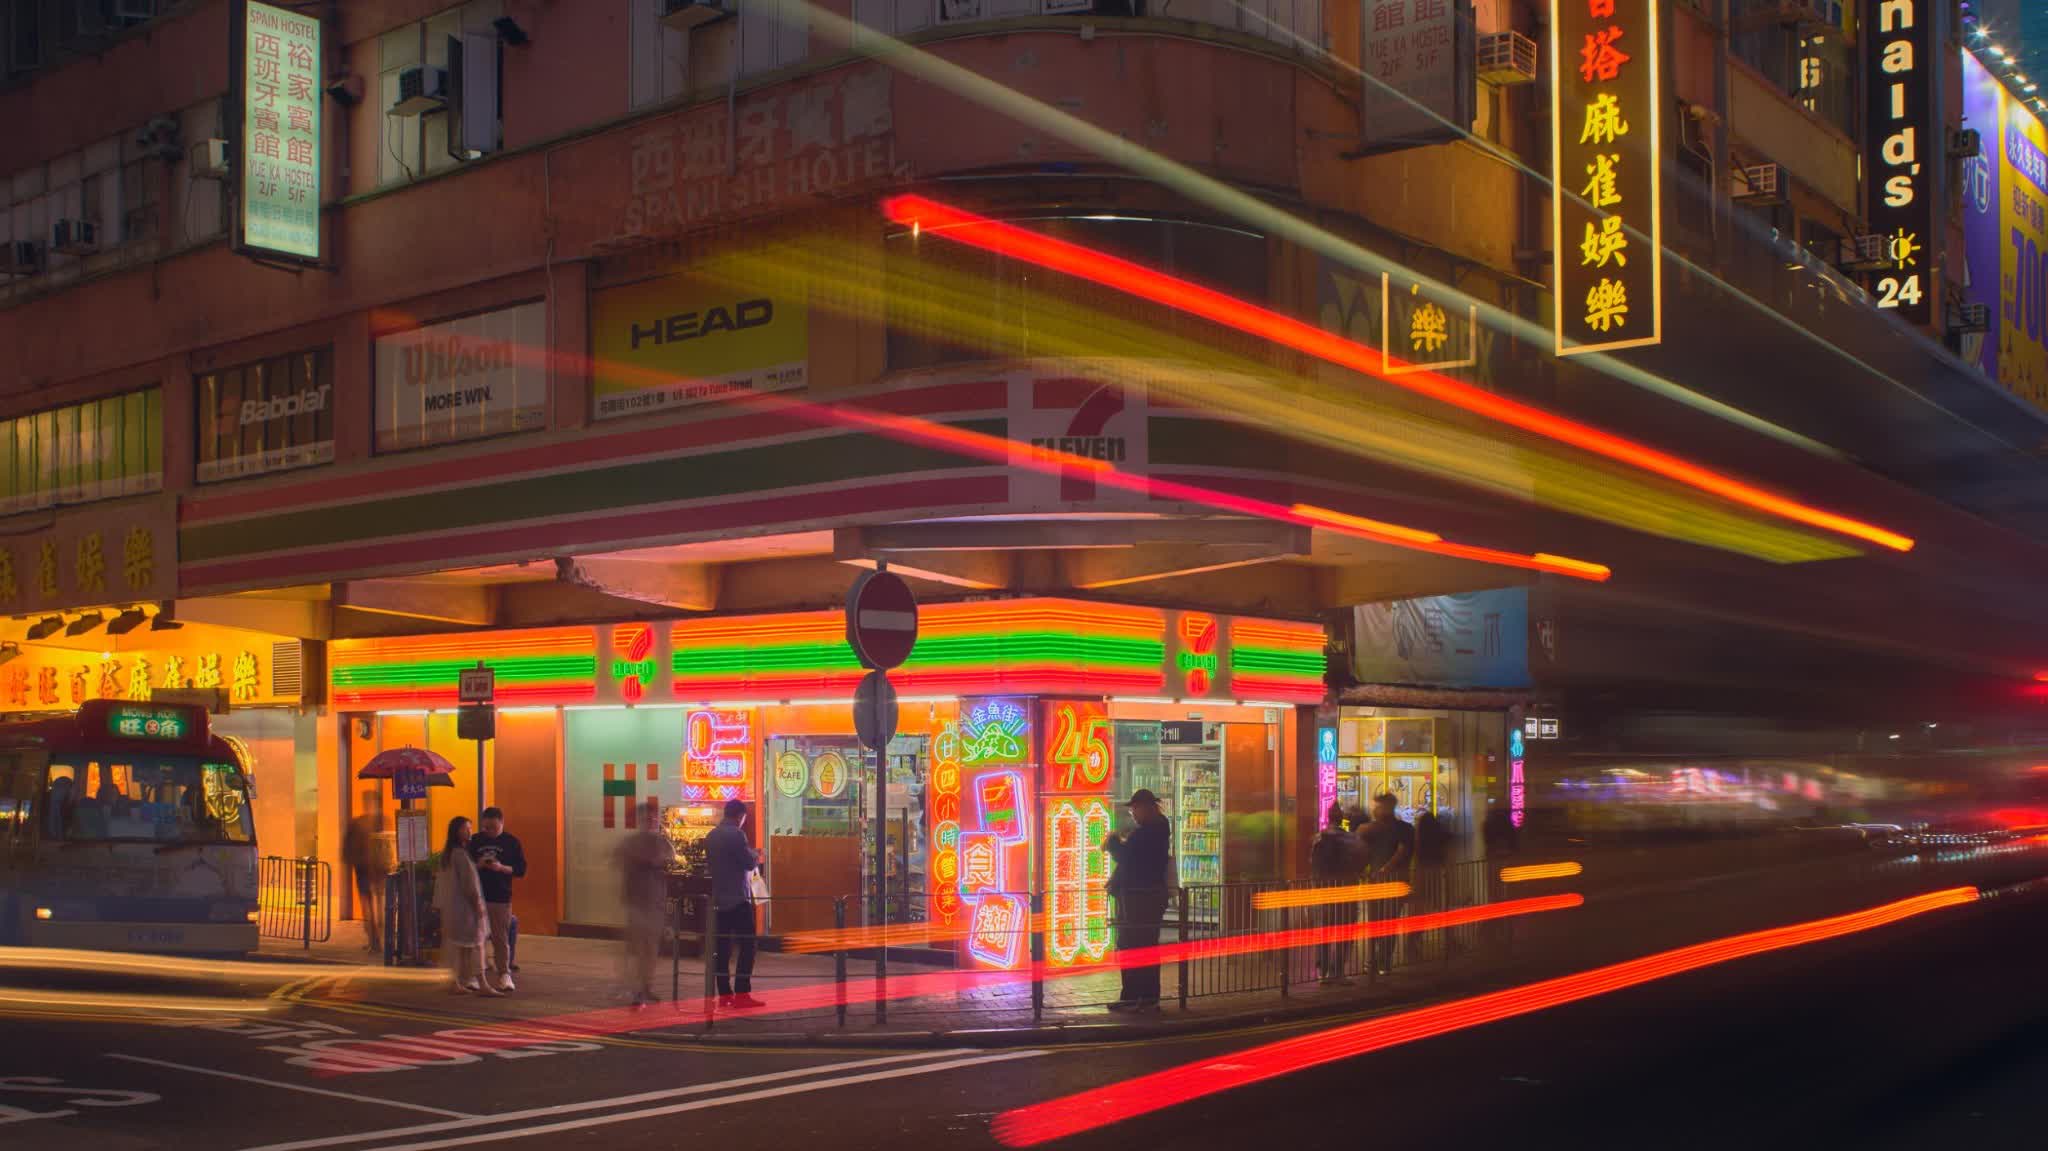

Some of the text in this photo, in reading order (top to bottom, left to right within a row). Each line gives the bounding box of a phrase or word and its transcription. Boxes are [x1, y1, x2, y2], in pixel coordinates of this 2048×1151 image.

[250, 9, 316, 41] SPAIN HOSTEL
[1369, 24, 1450, 58] YUE KA HOSTEL
[1381, 51, 1440, 76] 2/F 5/F
[253, 32, 281, 161] 西班牙賓館
[287, 40, 313, 167] 裕家賓館
[249, 159, 265, 178] YUE
[285, 167, 315, 189] HOSTEL
[259, 181, 306, 203] 2/F 5/F
[1877, 275, 1922, 309] 24
[631, 298, 773, 350] HEAD
[401, 335, 512, 385] Wilson
[425, 391, 462, 413] MORE
[603, 763, 658, 829] Hi
